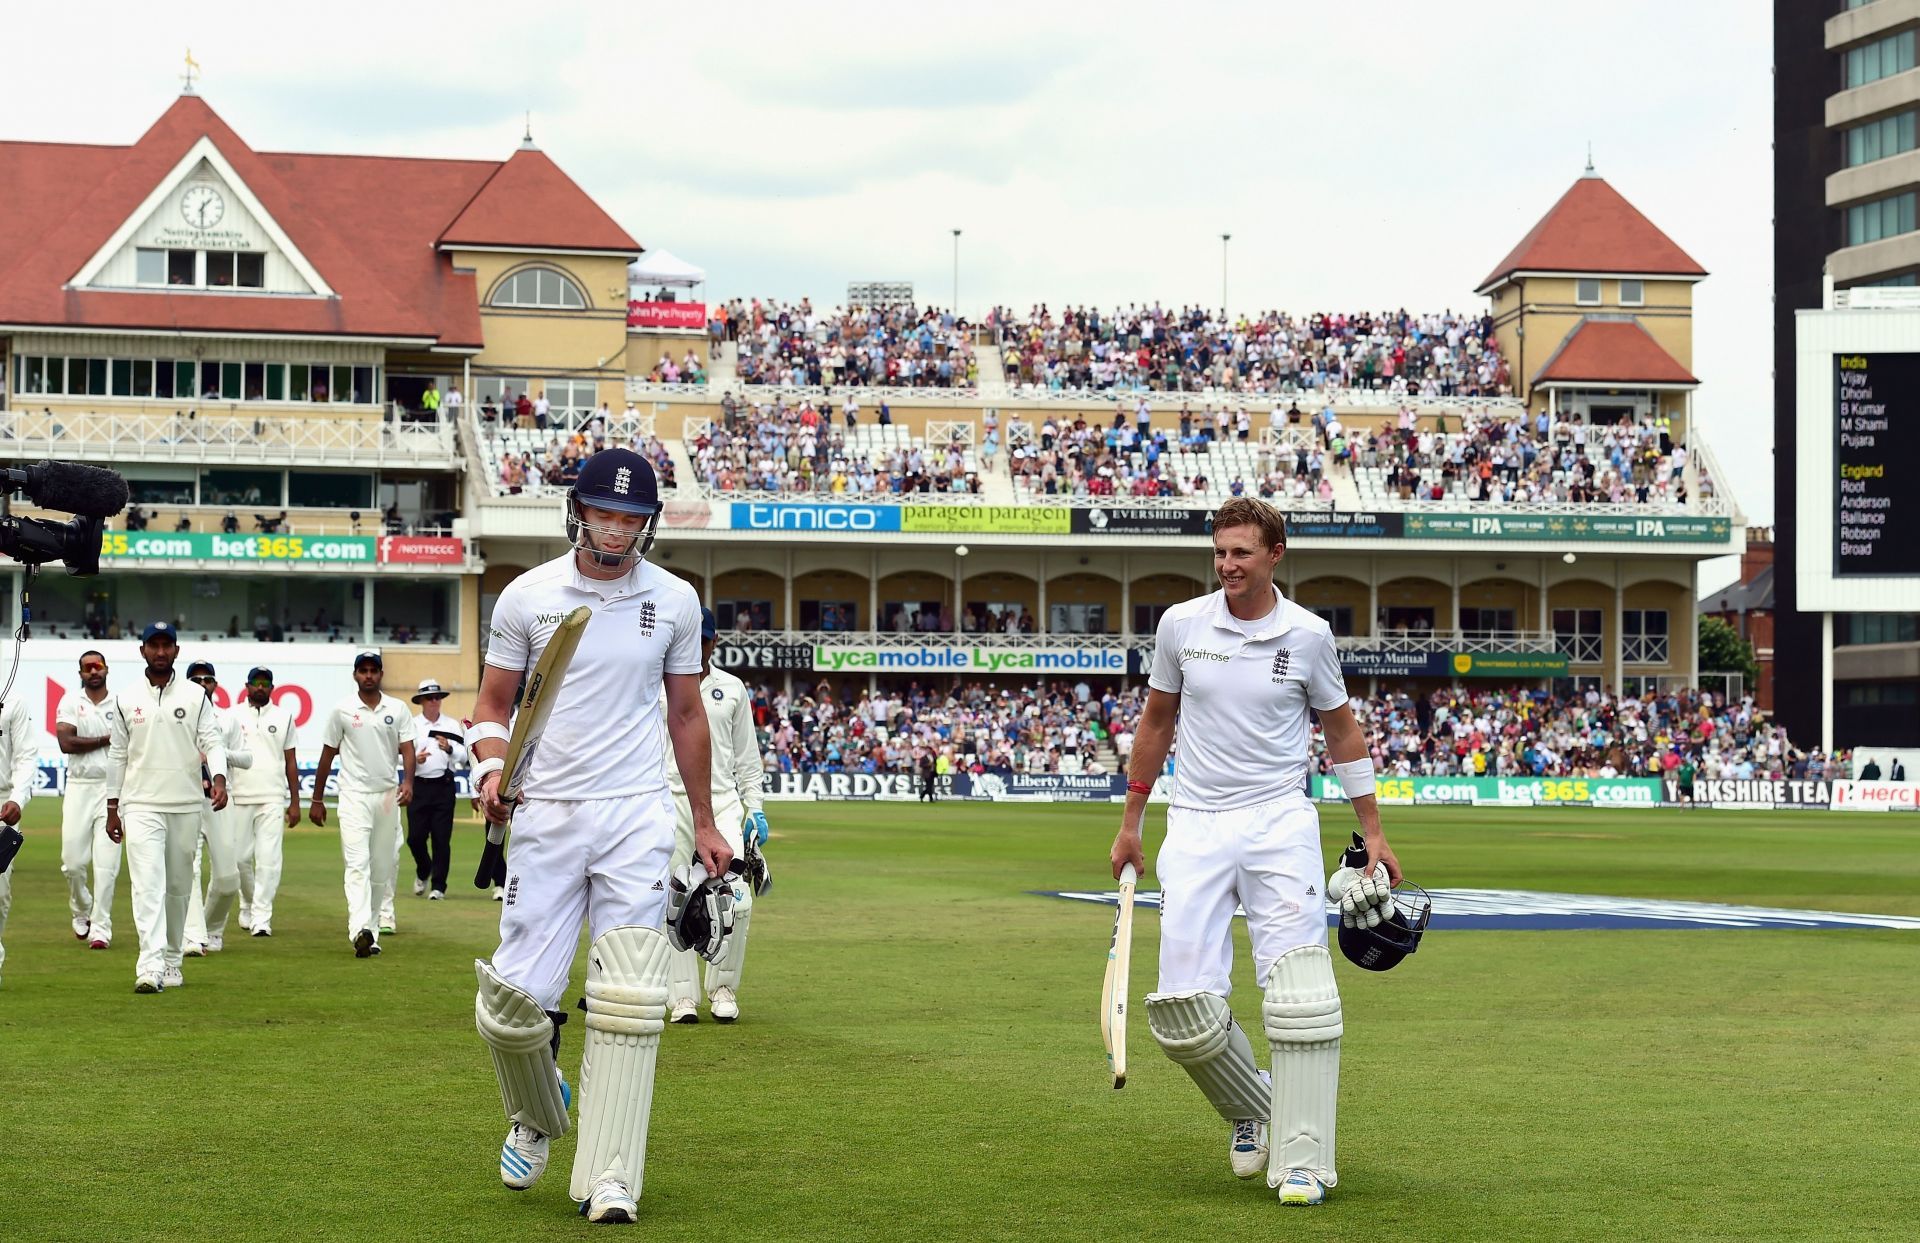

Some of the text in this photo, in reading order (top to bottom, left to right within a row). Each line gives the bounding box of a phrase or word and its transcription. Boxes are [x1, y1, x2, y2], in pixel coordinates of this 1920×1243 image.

[163, 228, 243, 239] Nottinghamshire
[155, 237, 250, 248] County Cricket Club
[651, 306, 670, 320] Pye
[671, 307, 703, 322] Property
[1841, 356, 1867, 369] India
[1840, 371, 1867, 387] Vijay
[1841, 386, 1872, 400] Dhoni
[1841, 402, 1885, 416] B Kumar
[1841, 417, 1888, 431] M Shami
[1841, 433, 1875, 449] Pujara
[1841, 464, 1883, 480] England
[1841, 480, 1865, 493] Root
[1840, 495, 1891, 508] Anderson
[750, 504, 876, 529] timico
[904, 506, 1066, 524] paragon paragon
[1112, 510, 1190, 519] EVERSHEDS
[1290, 512, 1331, 523] business
[1332, 512, 1351, 523] law
[1354, 512, 1376, 524] firm
[1841, 510, 1885, 524] Ballance
[1472, 518, 1502, 534] IPA
[1618, 523, 1634, 531] KING
[1636, 520, 1665, 536] IPA
[1841, 526, 1881, 540] Robson
[101, 534, 192, 556] 65.com
[211, 535, 366, 559] bet365.com
[397, 543, 455, 555] /NOTTSCCC
[1841, 541, 1872, 555] Broad
[536, 612, 566, 624] Wait
[711, 647, 774, 667] RDYS
[777, 648, 811, 657] ESTD
[816, 647, 1123, 671] Lycamobile Lycamobile
[1183, 648, 1230, 662] Waitrose
[1340, 652, 1427, 667] Liberty Mutual
[777, 658, 811, 668] 1853
[524, 672, 543, 709] V1200
[780, 774, 911, 796] HARDYS
[1013, 775, 1111, 791] Liberty Mutual
[1322, 779, 1478, 800] b65.com
[914, 786, 952, 798] 153
[1498, 780, 1651, 801] bet365.com
[1666, 780, 1830, 803] YRKSHIRE TEA
